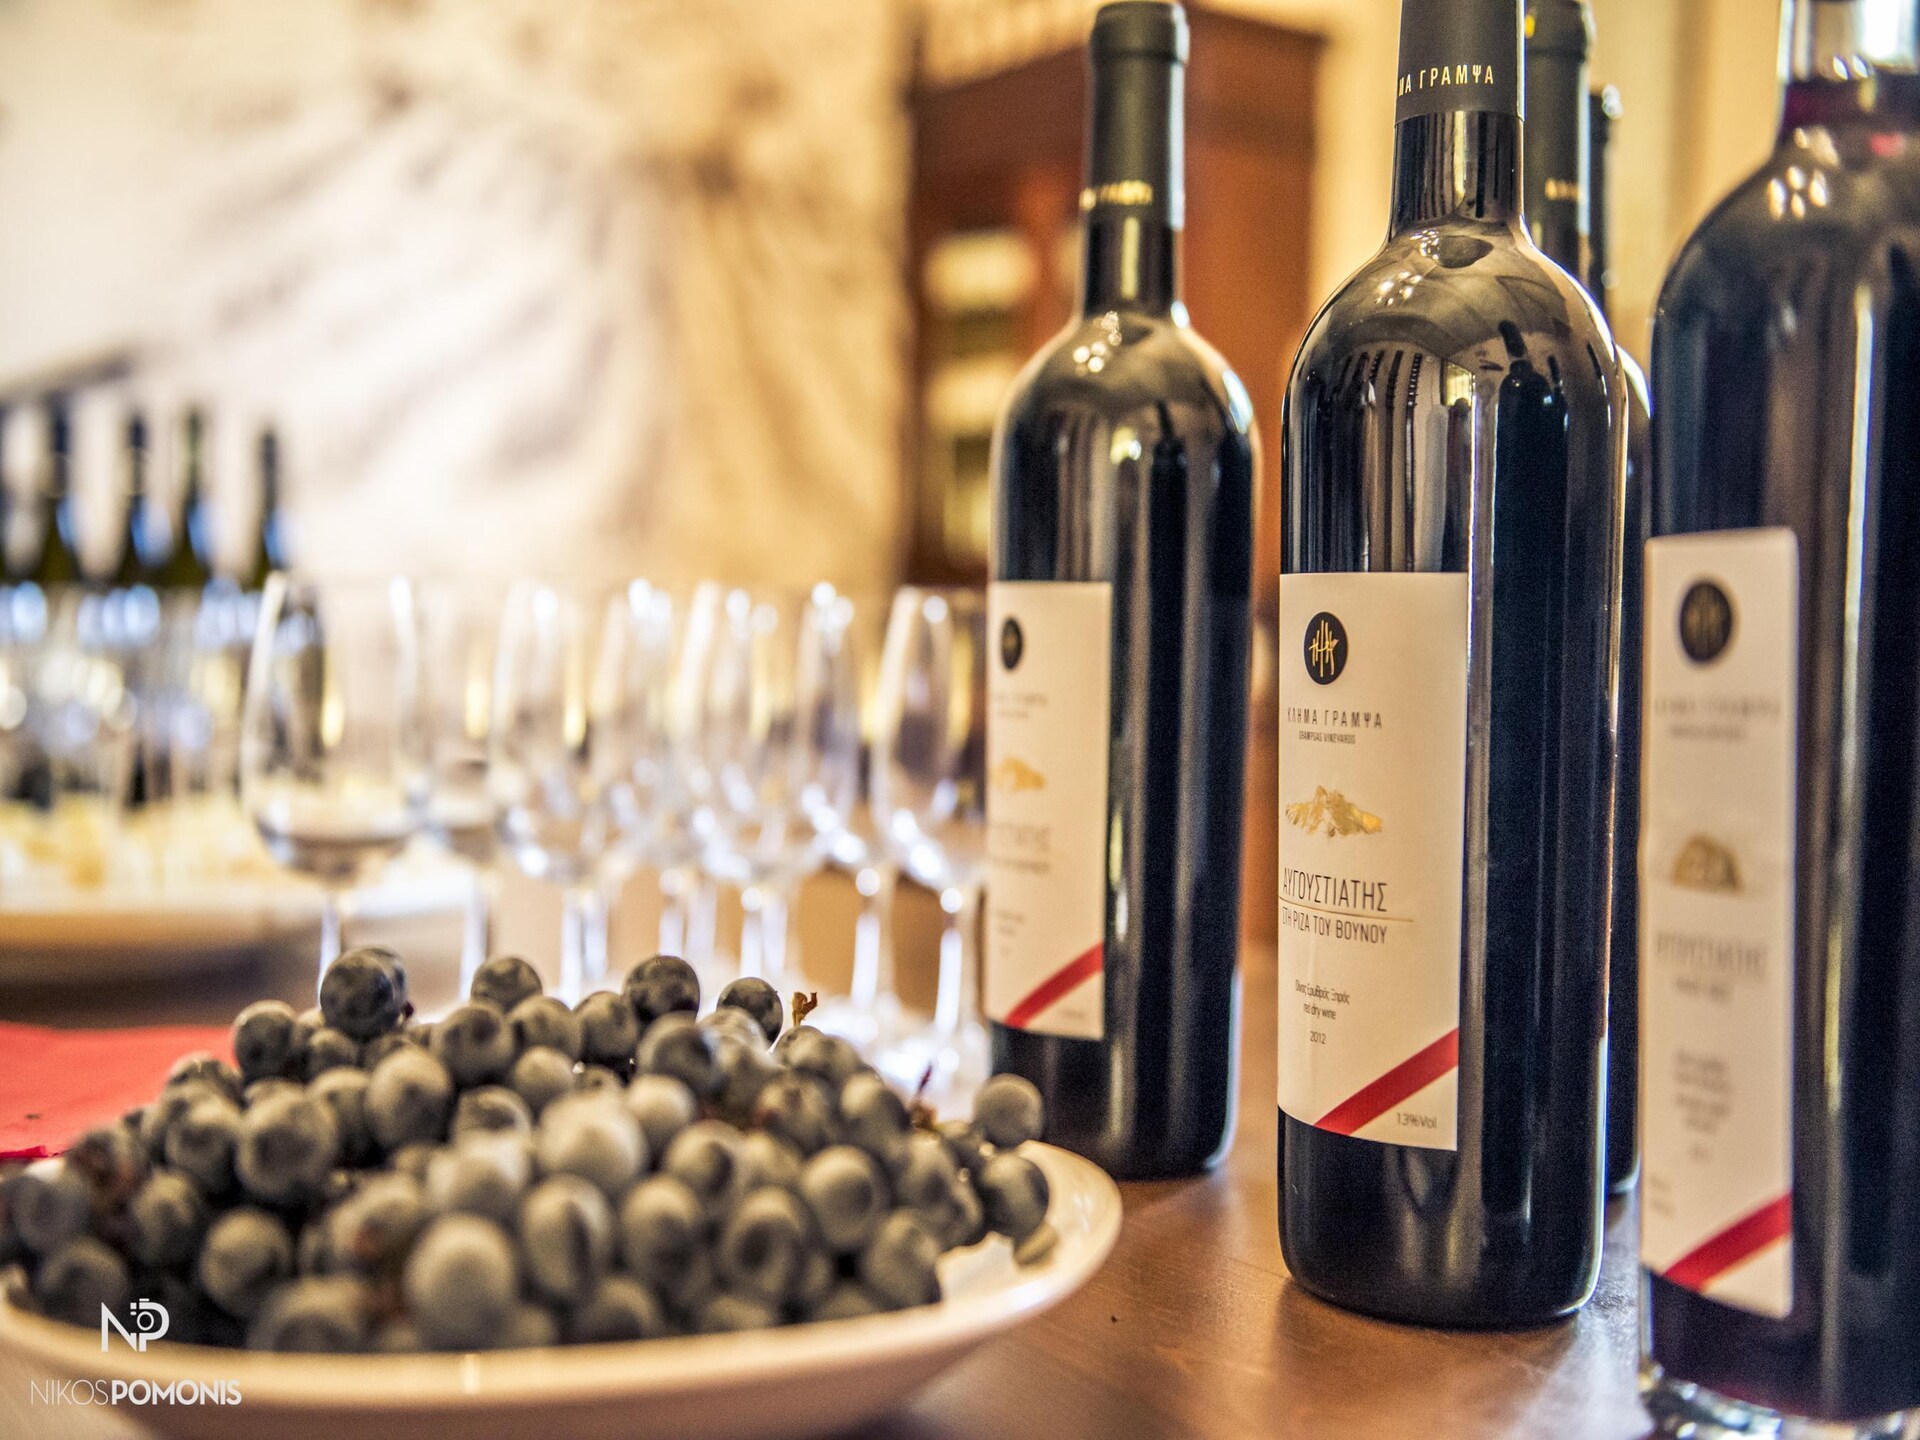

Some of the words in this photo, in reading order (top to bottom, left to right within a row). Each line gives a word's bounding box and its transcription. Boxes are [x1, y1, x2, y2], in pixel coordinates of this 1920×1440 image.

[1419, 64, 1494, 89] ΓΡΑΜΨΑ
[1324, 709, 1382, 729] ΓΡΑΜΨΑ
[1283, 867, 1387, 912] ΑΥΓΟΥΣΤΙΑΤΗΣ
[1313, 914, 1331, 936] ΤΟΥ
[1336, 919, 1387, 944] ΒΟΥΝΟΥ
[1310, 1030, 1327, 1045] 2012
